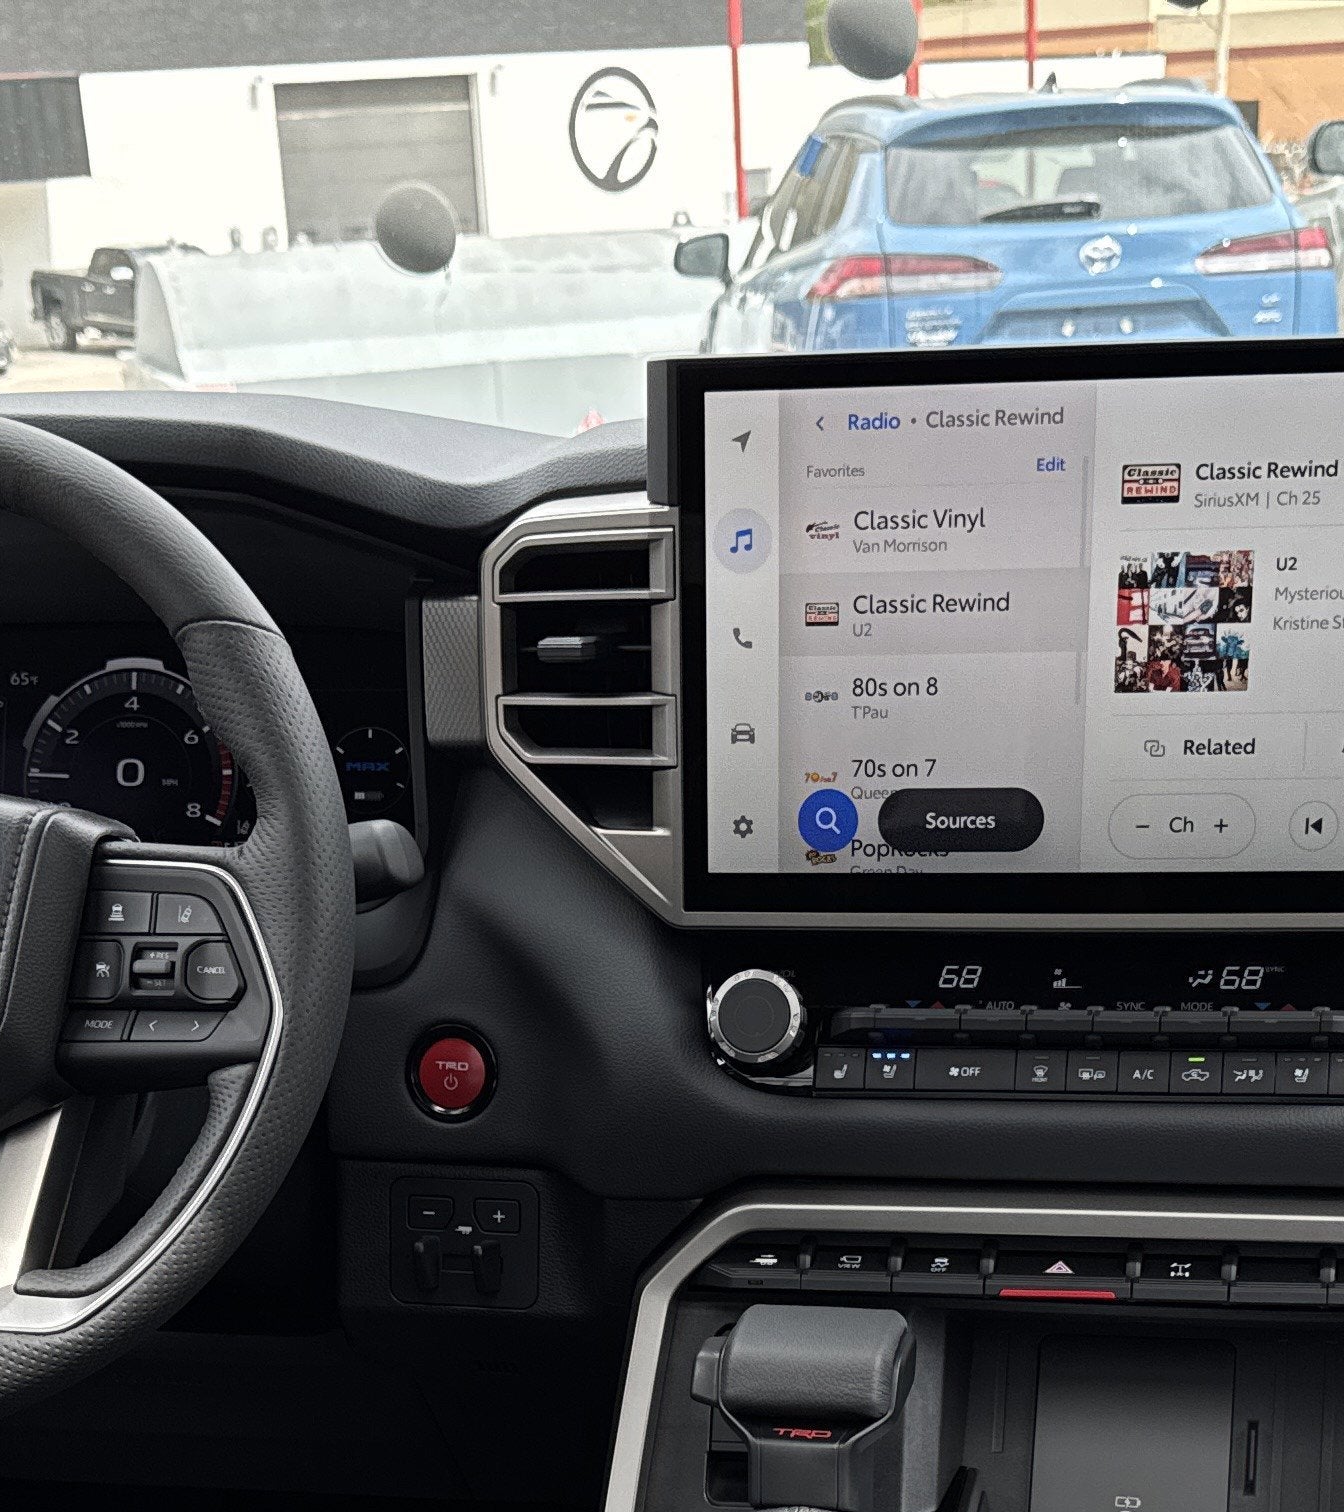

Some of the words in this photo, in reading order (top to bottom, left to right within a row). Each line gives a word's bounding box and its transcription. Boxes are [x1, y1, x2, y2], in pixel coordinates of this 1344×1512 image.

[847, 412, 901, 431] Radio
[925, 409, 991, 428] Classic
[994, 407, 1065, 426] Rewind
[805, 463, 866, 479] Favorites
[1036, 457, 1067, 472] Edit
[1195, 462, 1262, 482] Classic
[1267, 459, 1339, 480] Rewind
[1126, 484, 1178, 496] REWIND
[1193, 491, 1260, 508] SiriusXM
[1277, 491, 1299, 507] Ch
[1302, 490, 1322, 507] 25
[853, 509, 930, 531] Classic
[933, 506, 987, 533] Vinyl
[852, 539, 881, 554] Van
[883, 537, 948, 554] Morrison
[1275, 557, 1299, 573] U2
[853, 594, 927, 615] Classic
[932, 591, 1010, 613] Rewind
[852, 623, 873, 638] U2
[1272, 615, 1328, 631] Kristine
[851, 677, 888, 698] 80s
[892, 681, 921, 697] on
[926, 677, 939, 697] 8
[124, 696, 140, 712] 4
[65, 729, 80, 745] 2
[183, 729, 199, 745] 6
[1183, 738, 1256, 756] Related
[116, 758, 145, 787] 0
[851, 758, 887, 778] 70s
[892, 762, 919, 778] on
[924, 758, 938, 778] 7
[186, 802, 201, 818] 8
[924, 811, 996, 830] Sources
[1168, 816, 1195, 834] Ch
[197, 966, 226, 975] CANCEL
[938, 964, 983, 990] 68
[1219, 965, 1265, 990] 68
[985, 1000, 1015, 1011] AUTO
[1116, 1001, 1146, 1012] SYNC
[1180, 1002, 1214, 1012] MODE
[84, 1019, 113, 1029] MODE
[435, 1061, 469, 1071] TRD
[960, 1066, 982, 1078] OFF
[1132, 1068, 1155, 1081] A/C
[773, 1427, 833, 1440] TRD
